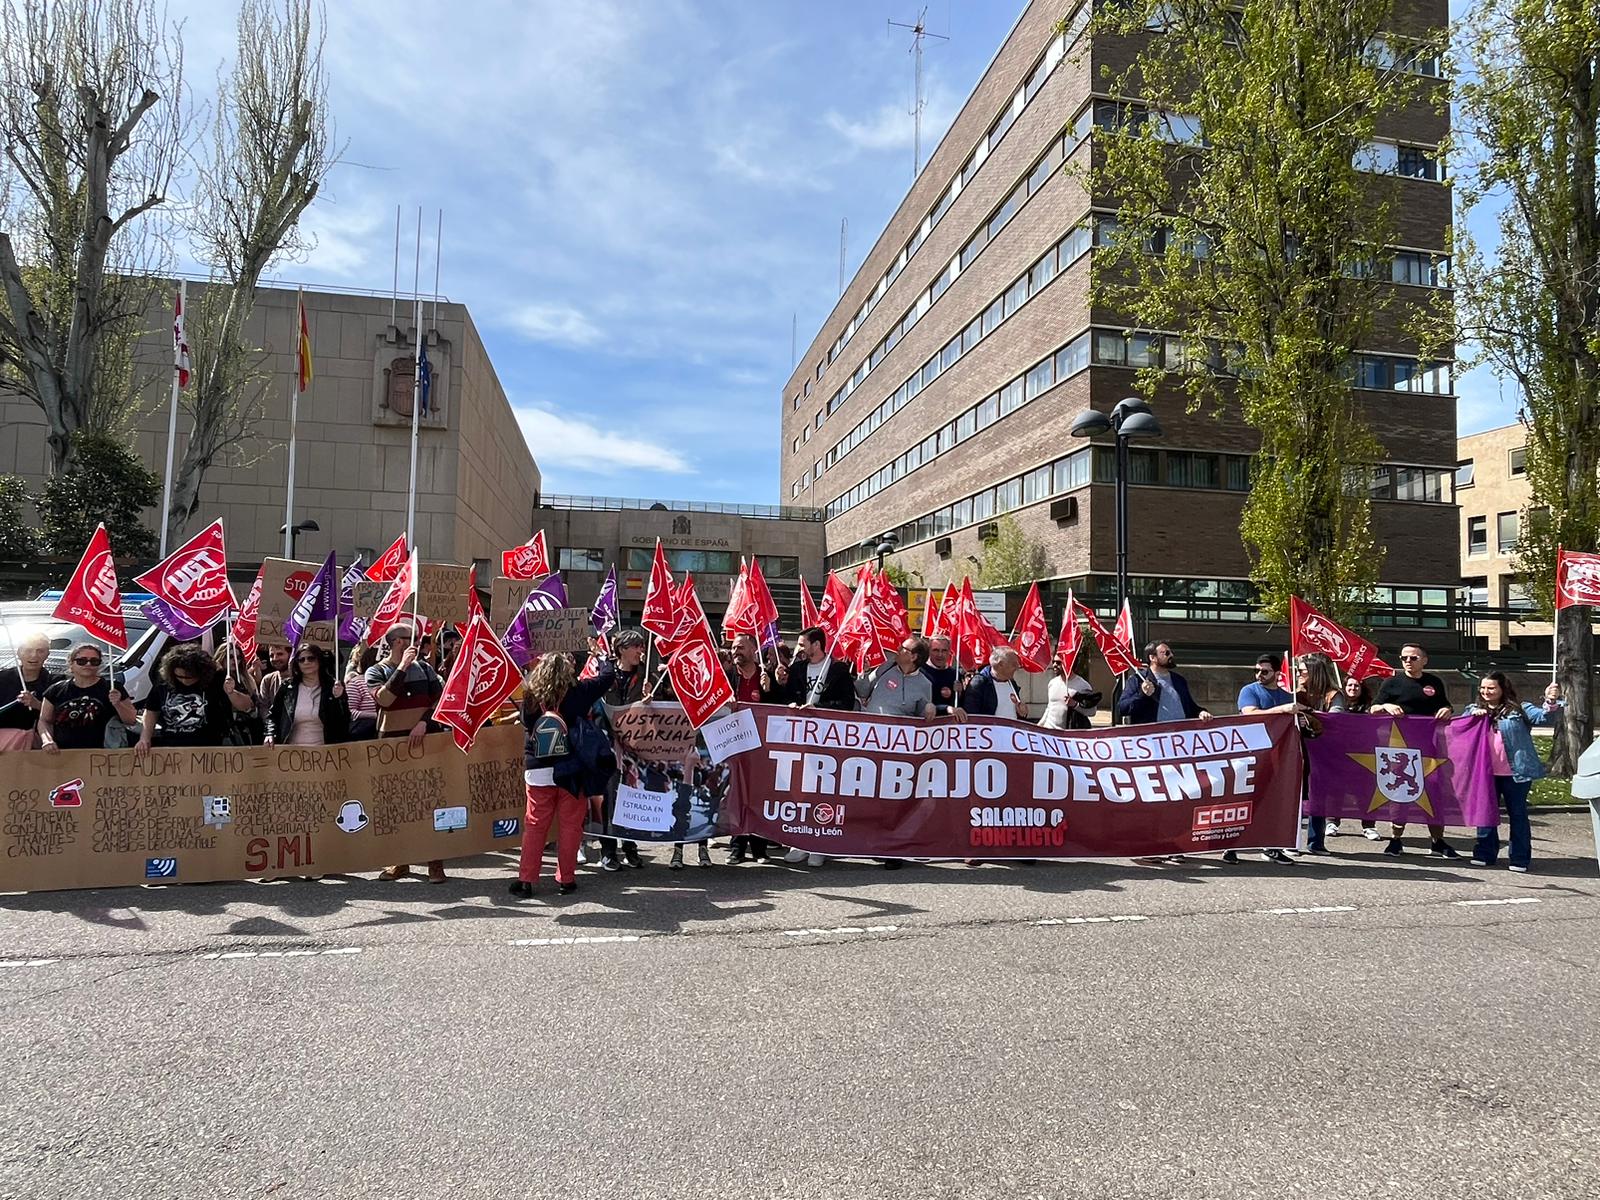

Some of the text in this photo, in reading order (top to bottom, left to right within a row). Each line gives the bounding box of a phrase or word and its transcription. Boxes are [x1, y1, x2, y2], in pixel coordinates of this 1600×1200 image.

[632, 536, 729, 547] GOBIRNO DE ESPAÑA
[165, 550, 220, 594] UGT
[284, 578, 308, 592] STO
[696, 687, 725, 717] www.ugt.es
[616, 714, 690, 728] JUSTICIA
[786, 718, 1248, 760] TRABAJADORES CENTRO ESTRADA
[90, 753, 181, 777] RECAUDAR
[191, 752, 244, 775] MUCHO
[278, 748, 352, 773] COBRAR
[367, 741, 425, 767] POCO
[768, 750, 1257, 803] TRABAJO DECENTE
[8, 788, 40, 801] 060
[95, 797, 128, 809] ALTAS
[145, 796, 178, 807] BAJAS
[622, 800, 652, 812] ESTRADA
[36, 810, 73, 822] PREVIA
[623, 812, 651, 822] HUELGA
[763, 800, 811, 822] UGT
[970, 807, 1046, 827] SALARIO
[1198, 806, 1249, 825] CCOO
[3, 821, 79, 835] CONSULTA DE
[262, 822, 320, 835] HABITUALES
[782, 824, 843, 837] Castilla y León
[969, 826, 1065, 847] CONFLICTO
[8, 844, 64, 857] CANJES
